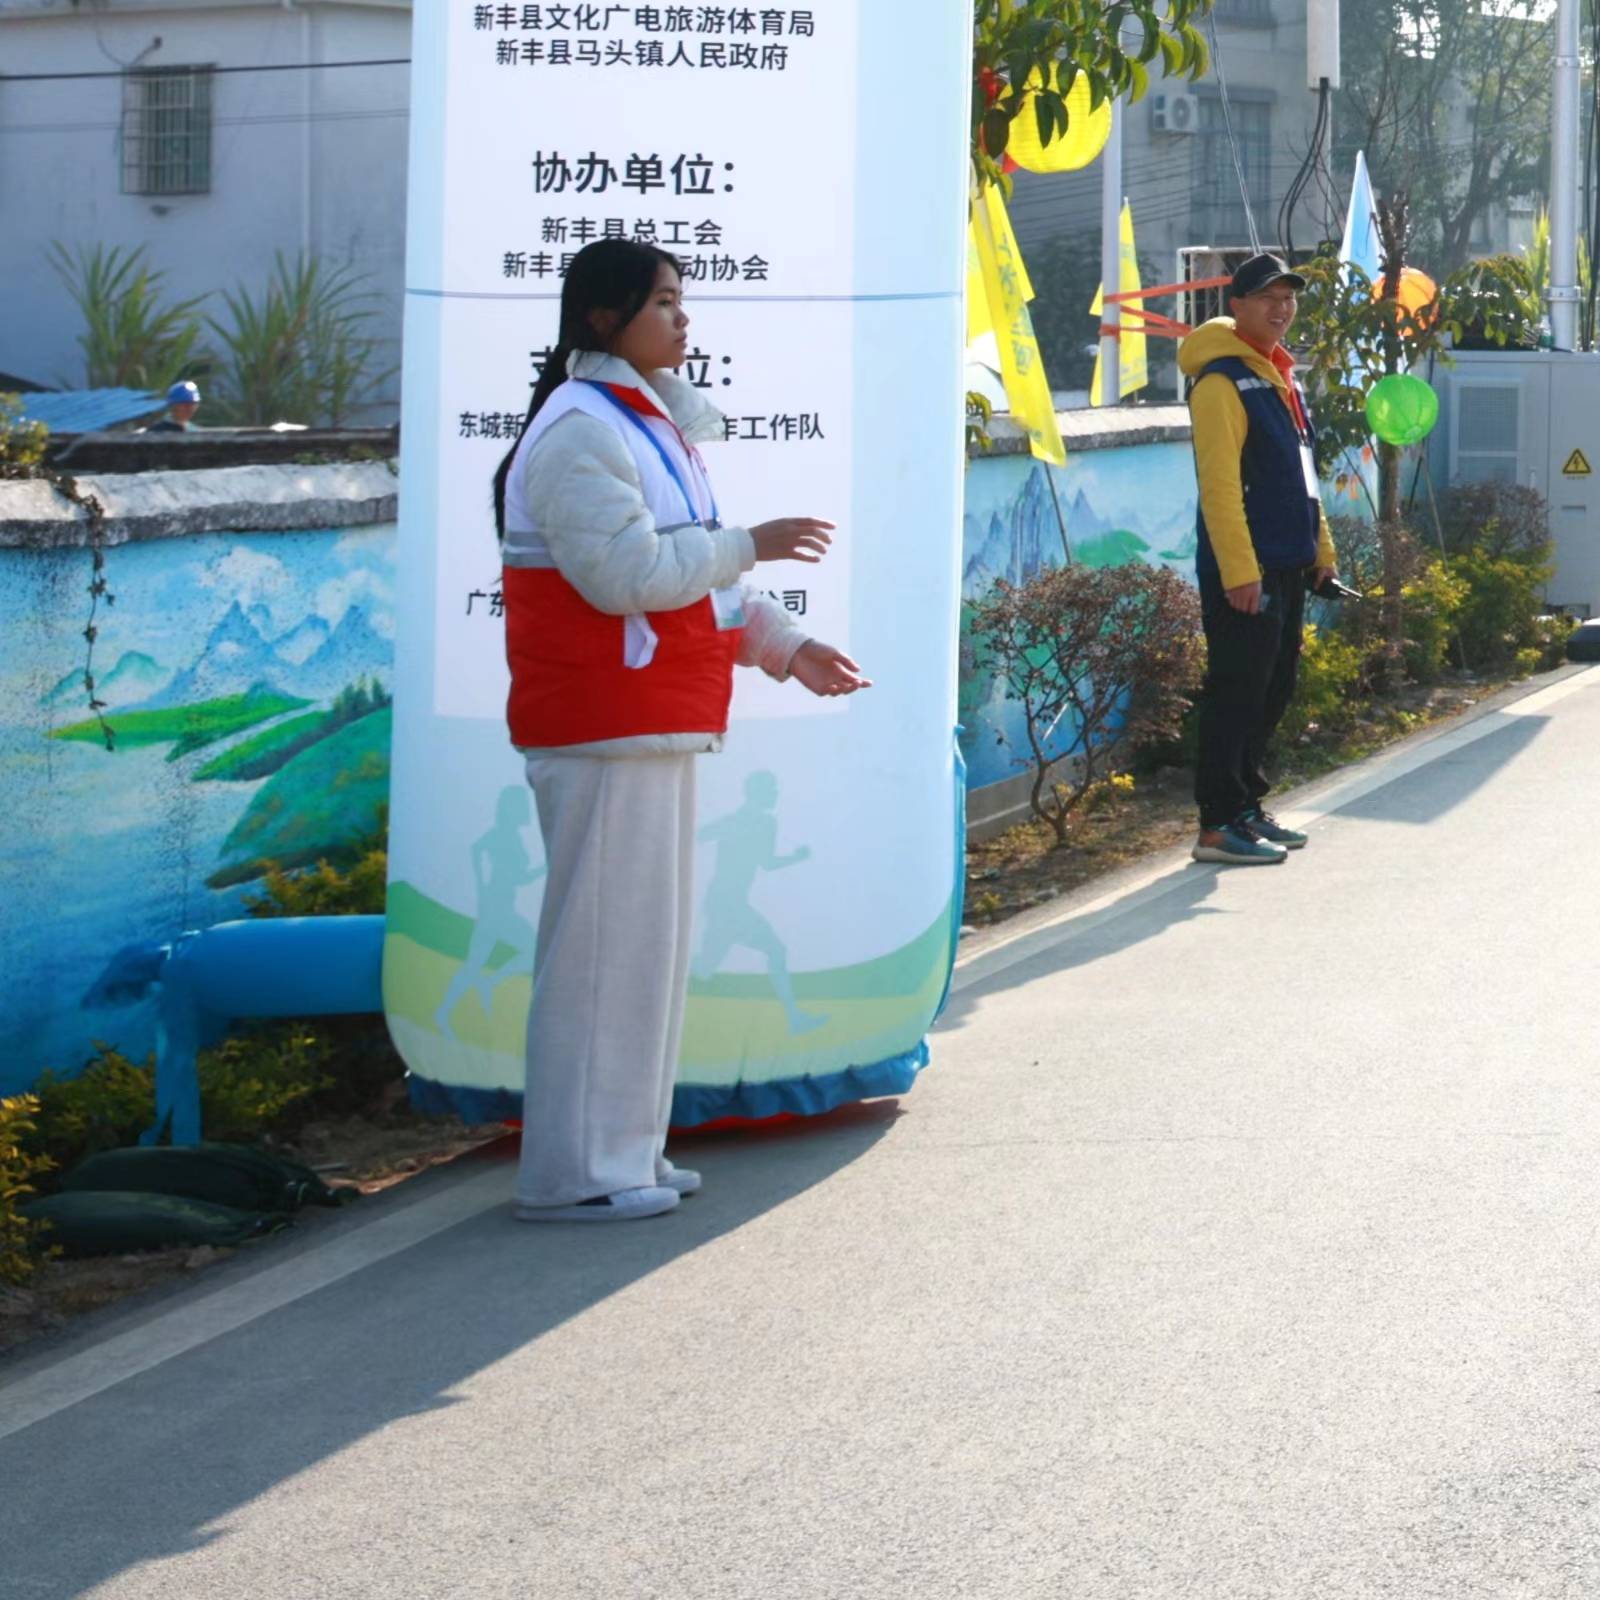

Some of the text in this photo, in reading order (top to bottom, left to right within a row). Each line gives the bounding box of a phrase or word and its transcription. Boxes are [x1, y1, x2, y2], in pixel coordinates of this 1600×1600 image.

[474, 4, 815, 37] 新丰县文化广电旅游体育局
[496, 38, 789, 71] 新丰县马头镇人民政府
[532, 150, 736, 195] 协办单位：
[541, 216, 723, 246] 新丰县总工会
